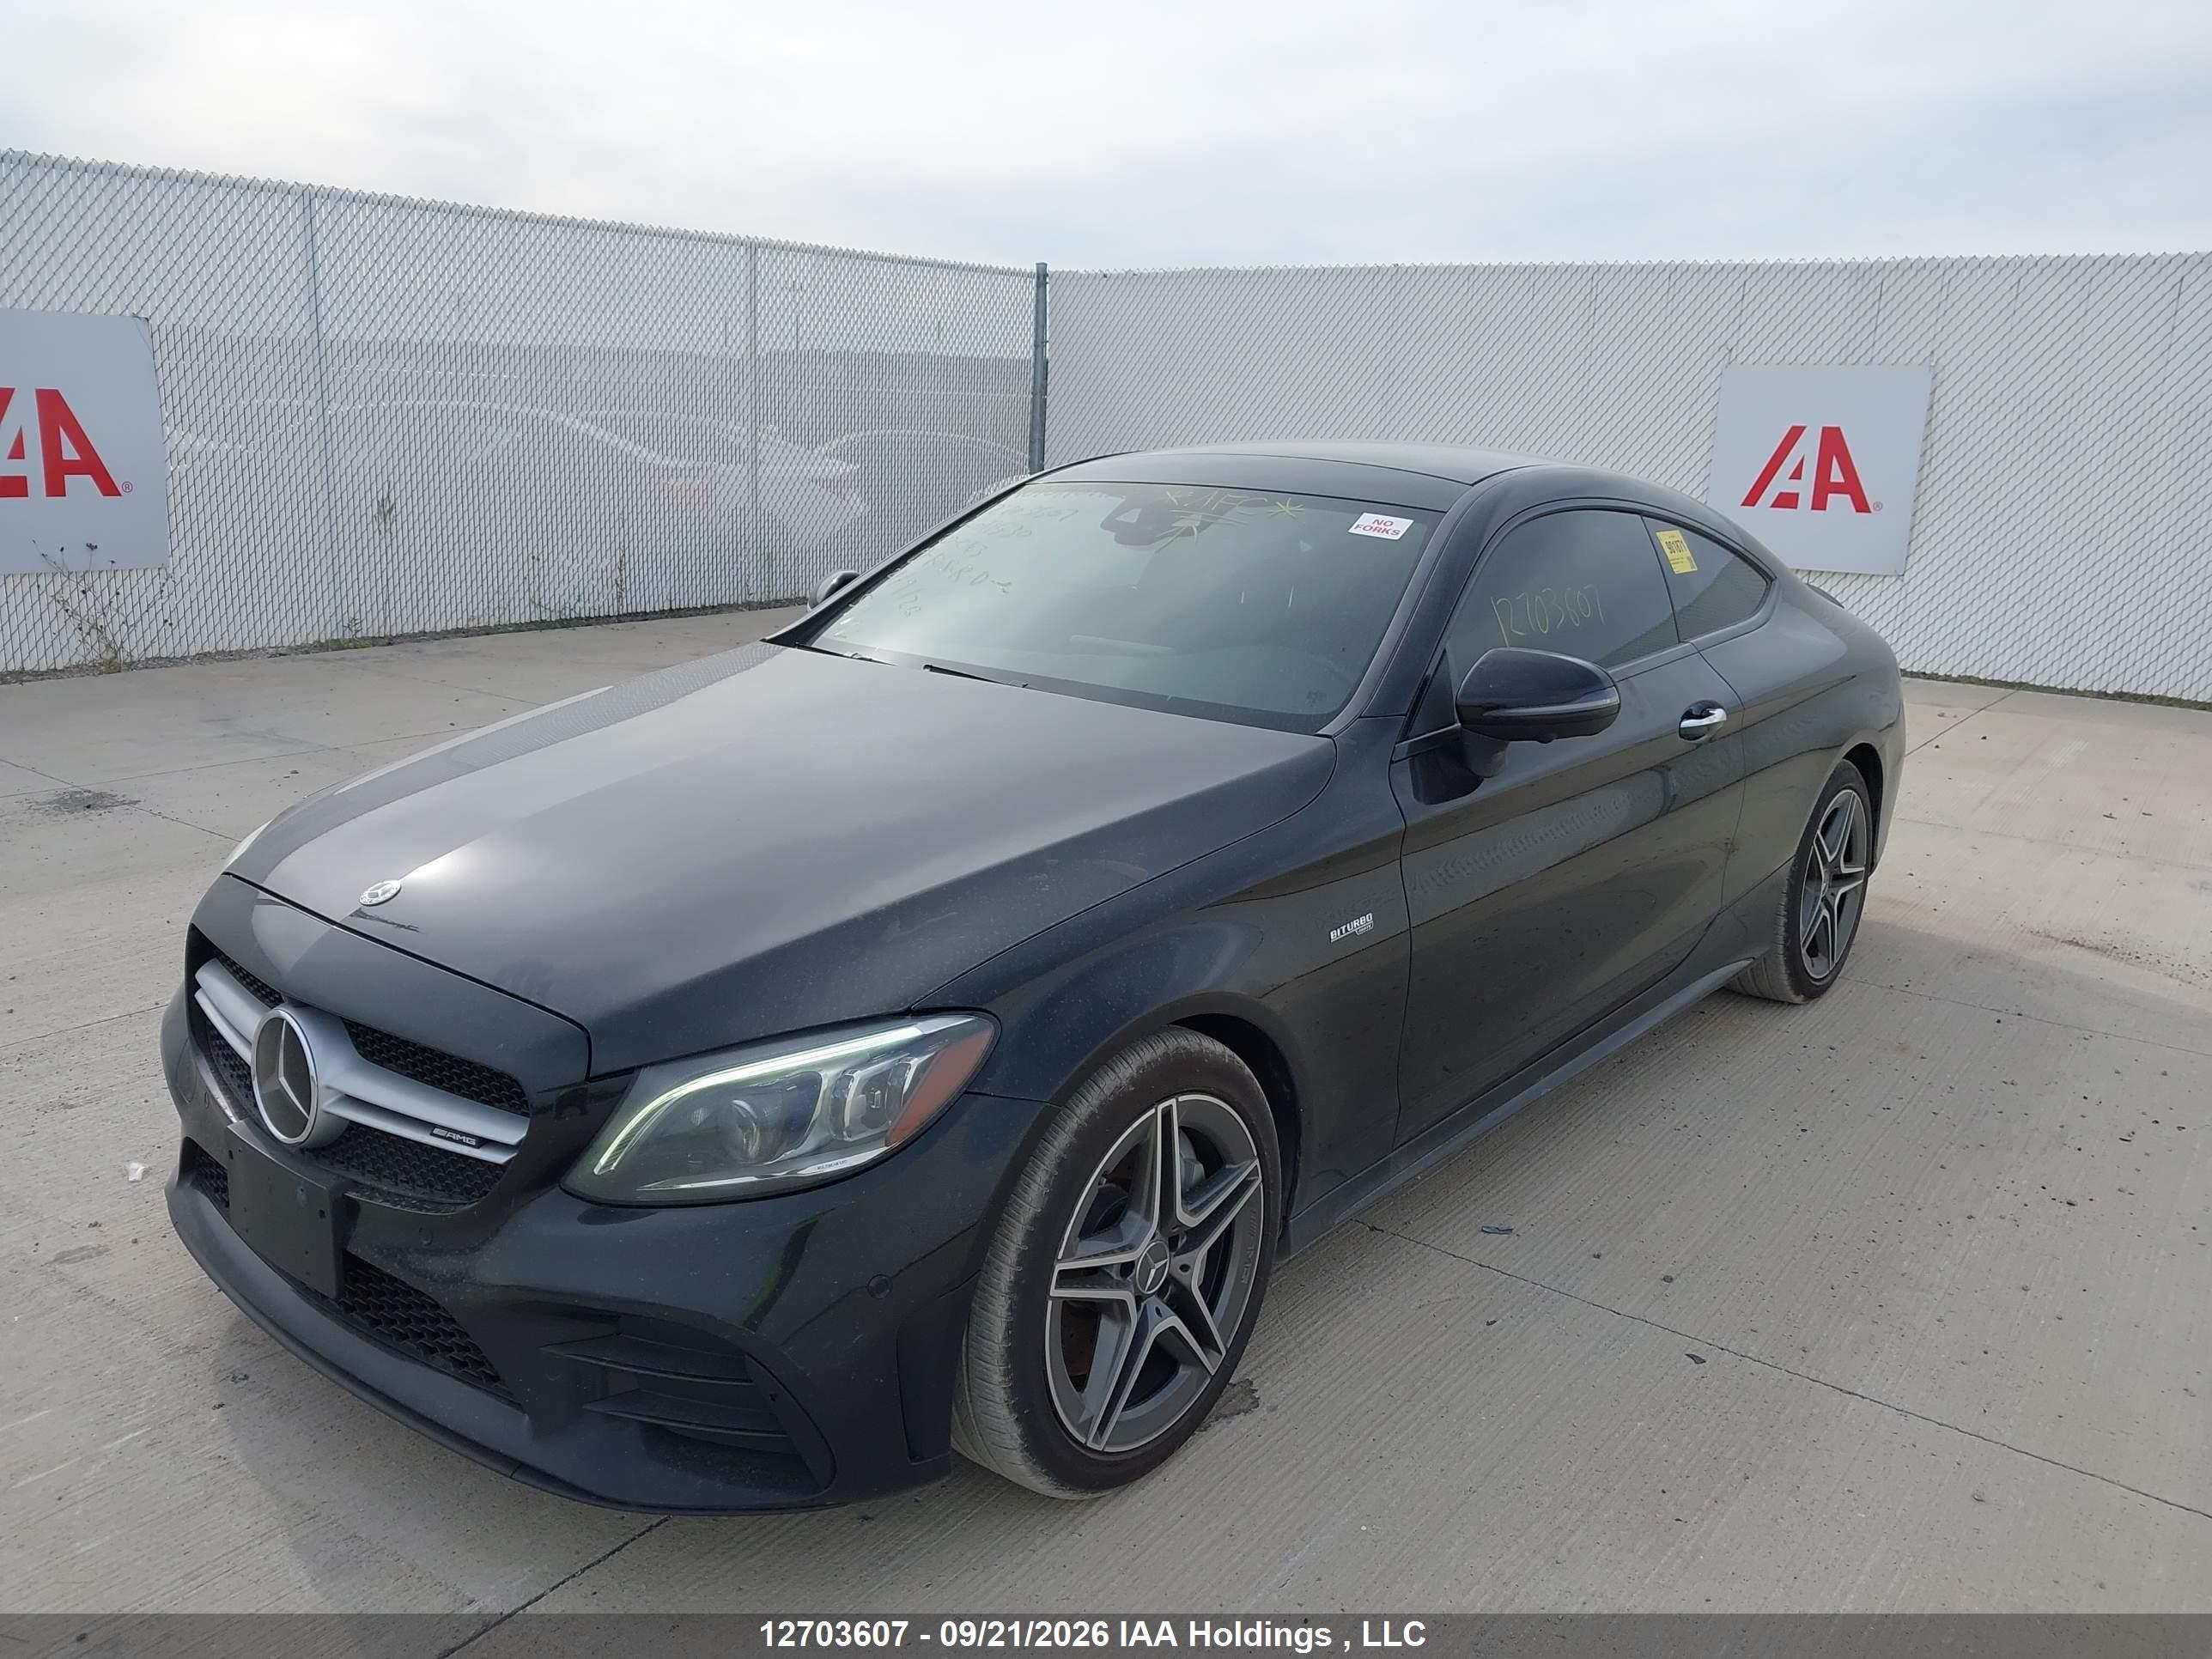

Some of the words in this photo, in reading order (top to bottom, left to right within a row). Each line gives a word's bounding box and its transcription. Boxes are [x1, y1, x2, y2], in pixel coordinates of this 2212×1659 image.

[1372, 519, 1395, 527] NO
[1354, 524, 1401, 537] FORKS
[1329, 912, 1373, 940] BITURBO
[446, 1131, 477, 1146] AMG
